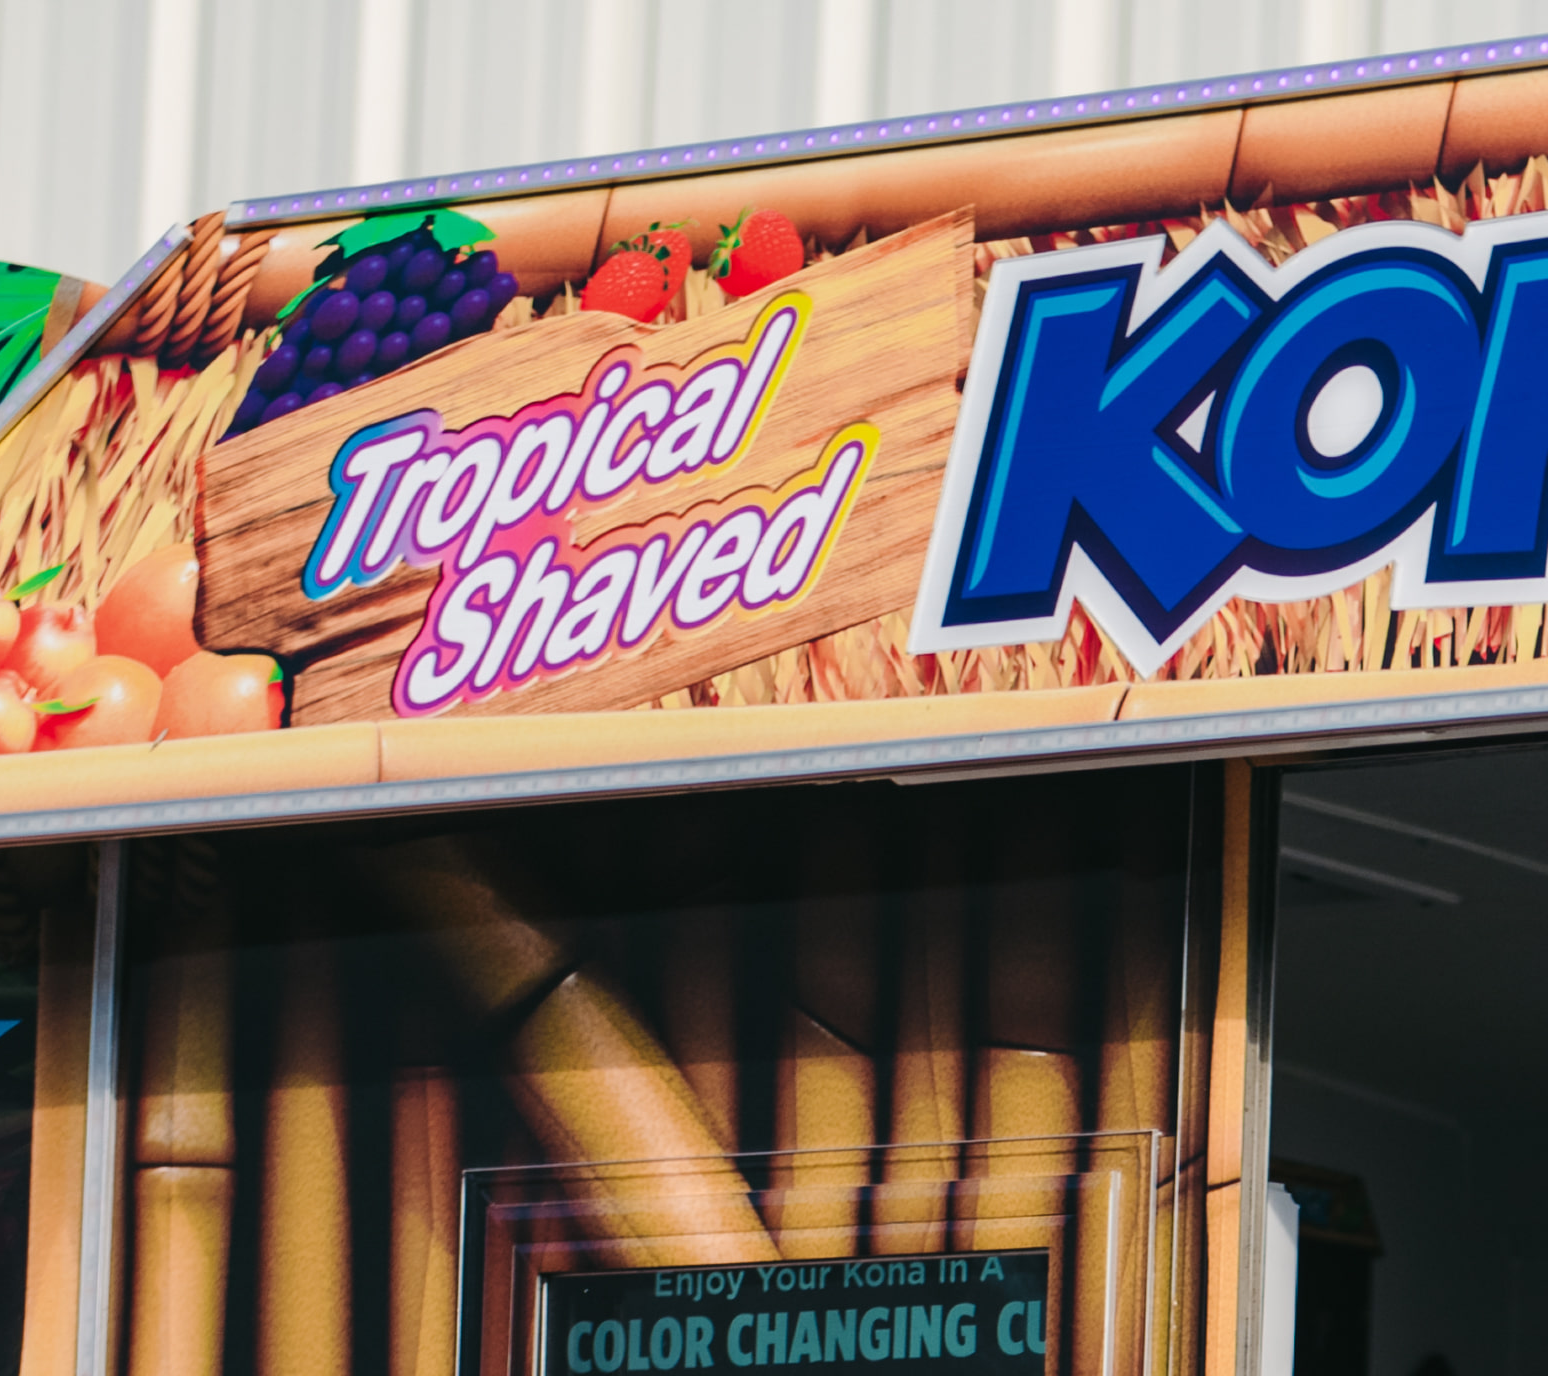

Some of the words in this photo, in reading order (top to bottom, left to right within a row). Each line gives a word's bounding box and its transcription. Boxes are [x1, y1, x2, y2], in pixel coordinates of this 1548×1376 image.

[309, 300, 804, 590] Tropical
[404, 433, 866, 710] Shaved
[566, 1316, 715, 1374] COLOR
[726, 1303, 977, 1367] CHANGING
[655, 1268, 746, 1301] Enjoy
[756, 1263, 831, 1292] Your
[843, 1259, 926, 1289] Kona
[979, 1256, 1005, 1282] A
